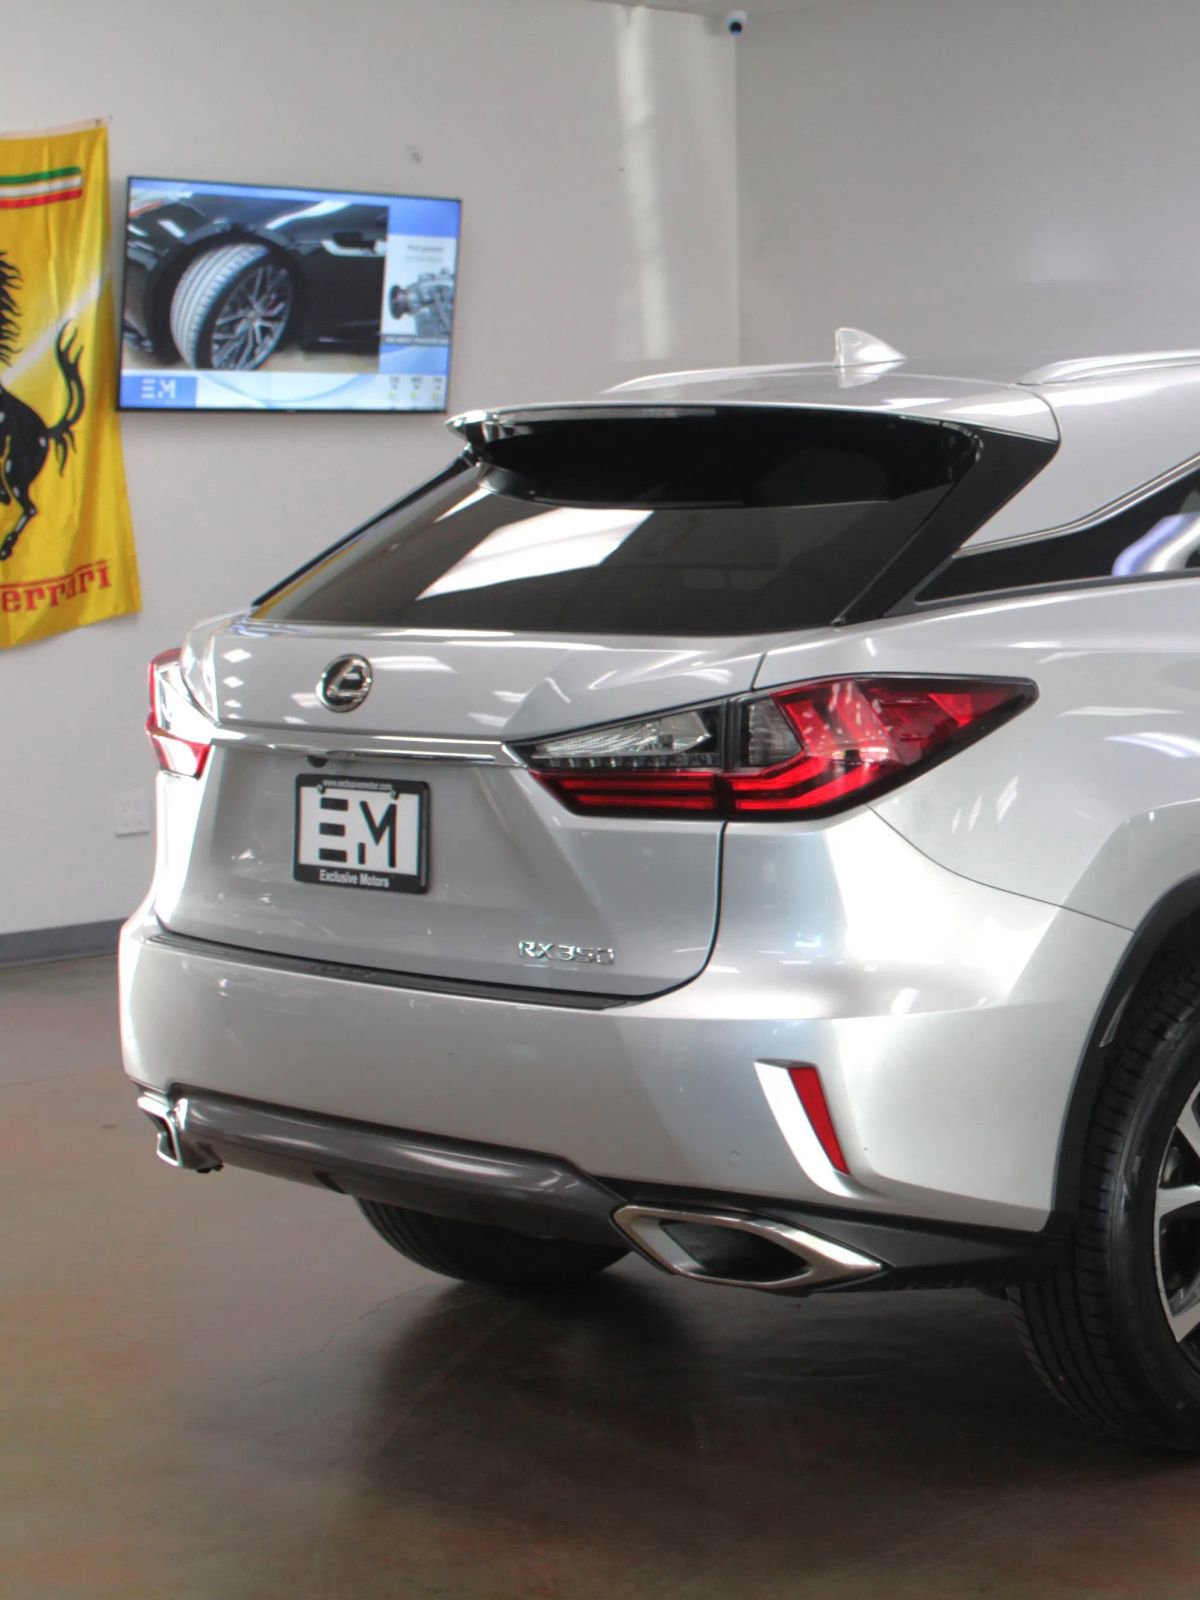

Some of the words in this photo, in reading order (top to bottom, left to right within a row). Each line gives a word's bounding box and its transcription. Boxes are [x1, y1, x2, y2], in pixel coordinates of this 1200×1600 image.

[141, 379, 176, 399] EM
[0, 560, 111, 612] errari
[318, 797, 397, 868] EM
[319, 869, 358, 885] Exclusive
[360, 873, 390, 888] Motors
